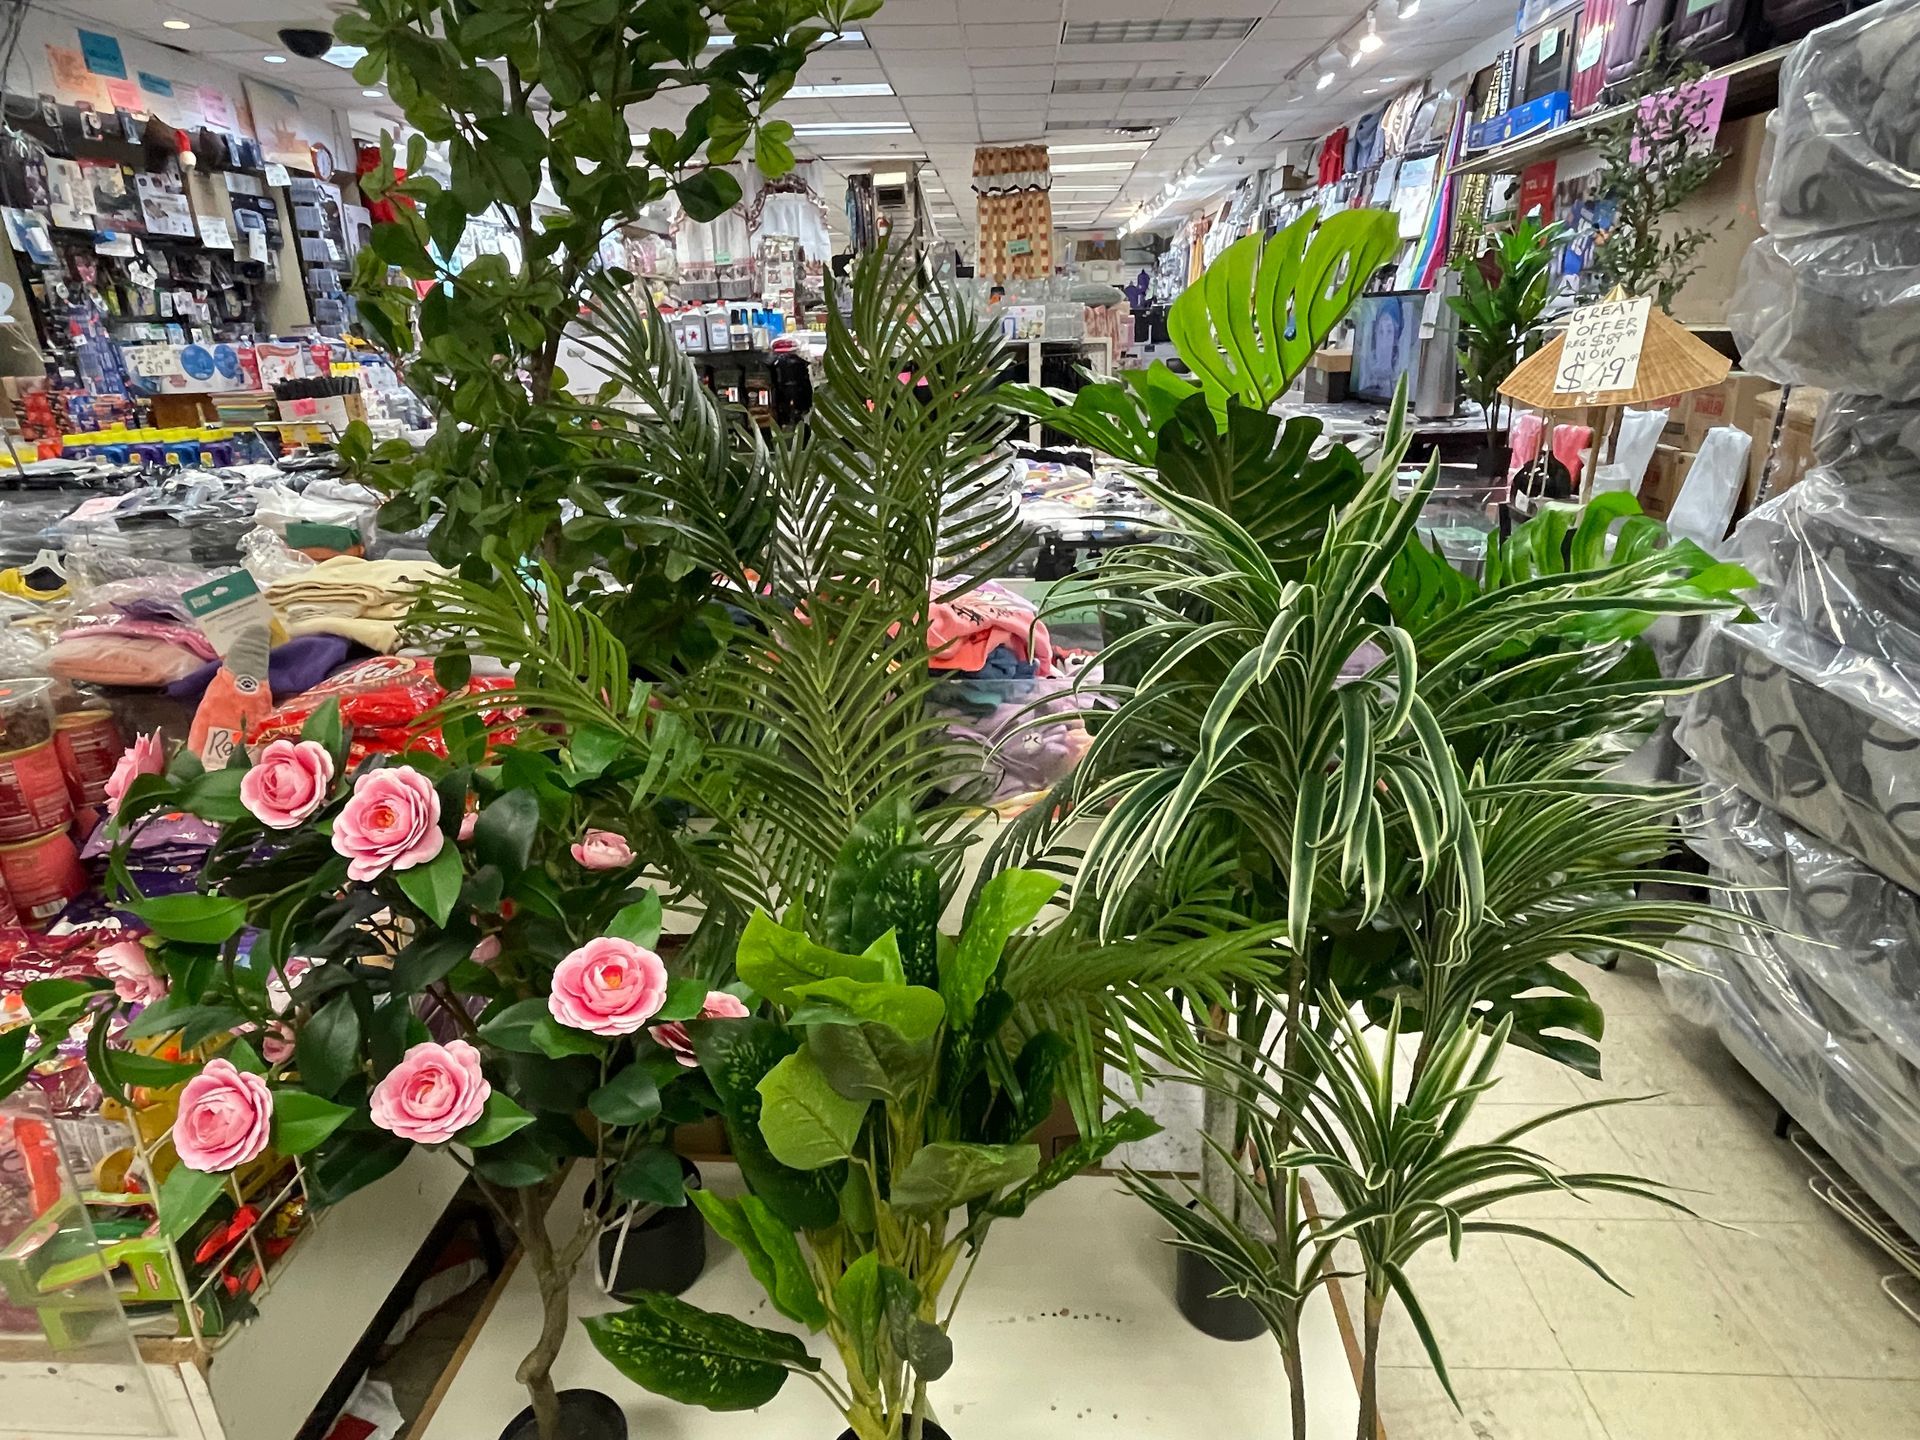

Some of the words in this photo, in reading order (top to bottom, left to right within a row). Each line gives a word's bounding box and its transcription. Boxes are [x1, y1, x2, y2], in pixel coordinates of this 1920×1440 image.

[1573, 300, 1639, 325] GREAT
[1576, 317, 1638, 337] OFFER
[1566, 338, 1587, 350] REG
[1575, 346, 1616, 362] NOW
